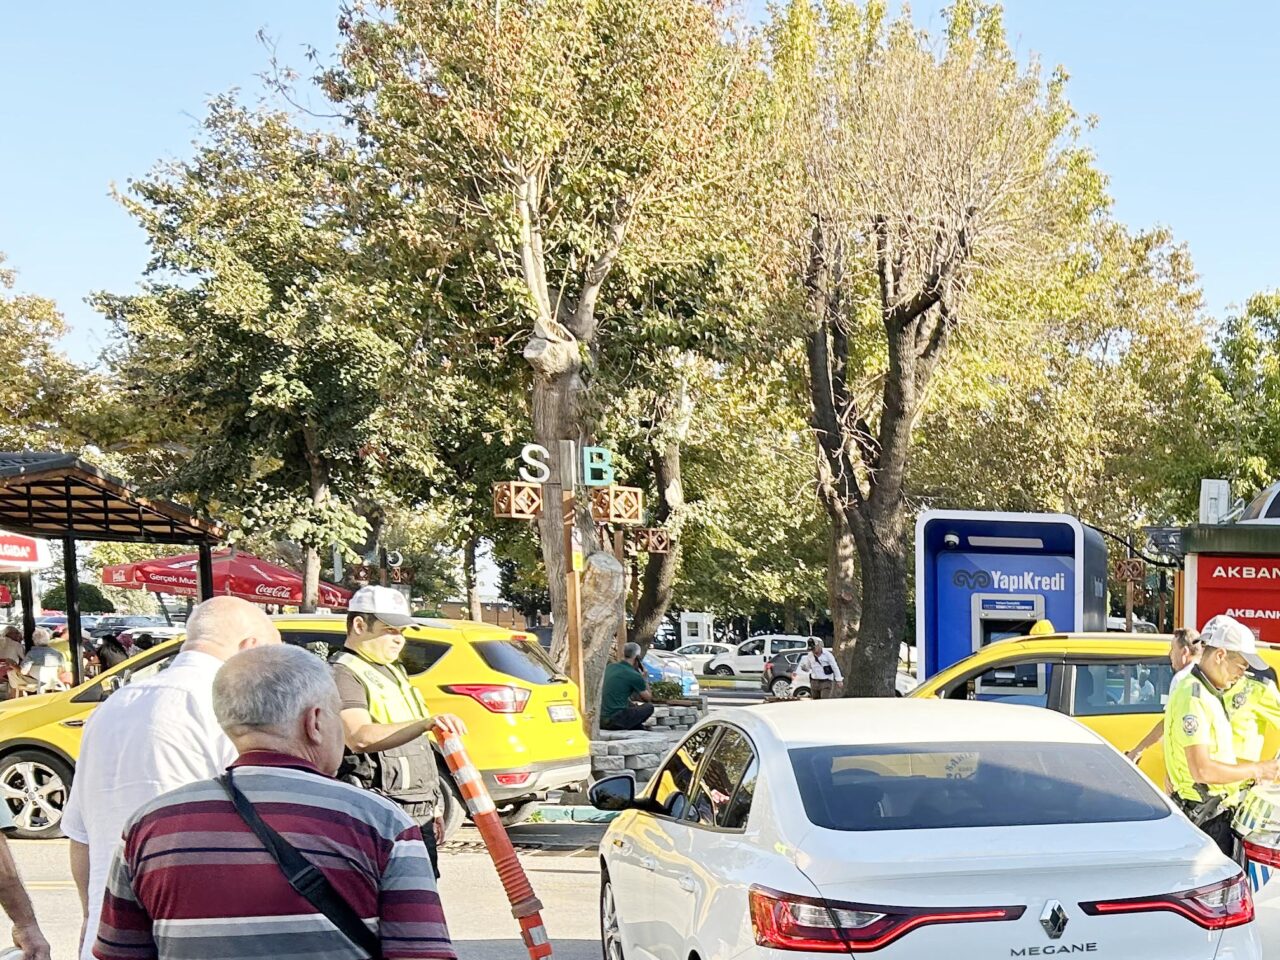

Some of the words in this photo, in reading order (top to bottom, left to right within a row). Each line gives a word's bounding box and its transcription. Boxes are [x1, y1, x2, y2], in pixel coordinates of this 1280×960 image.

[149, 573, 177, 583] Gerçek
[991, 570, 1065, 592] YapıKredi
[1010, 942, 1098, 957] MEGANE
